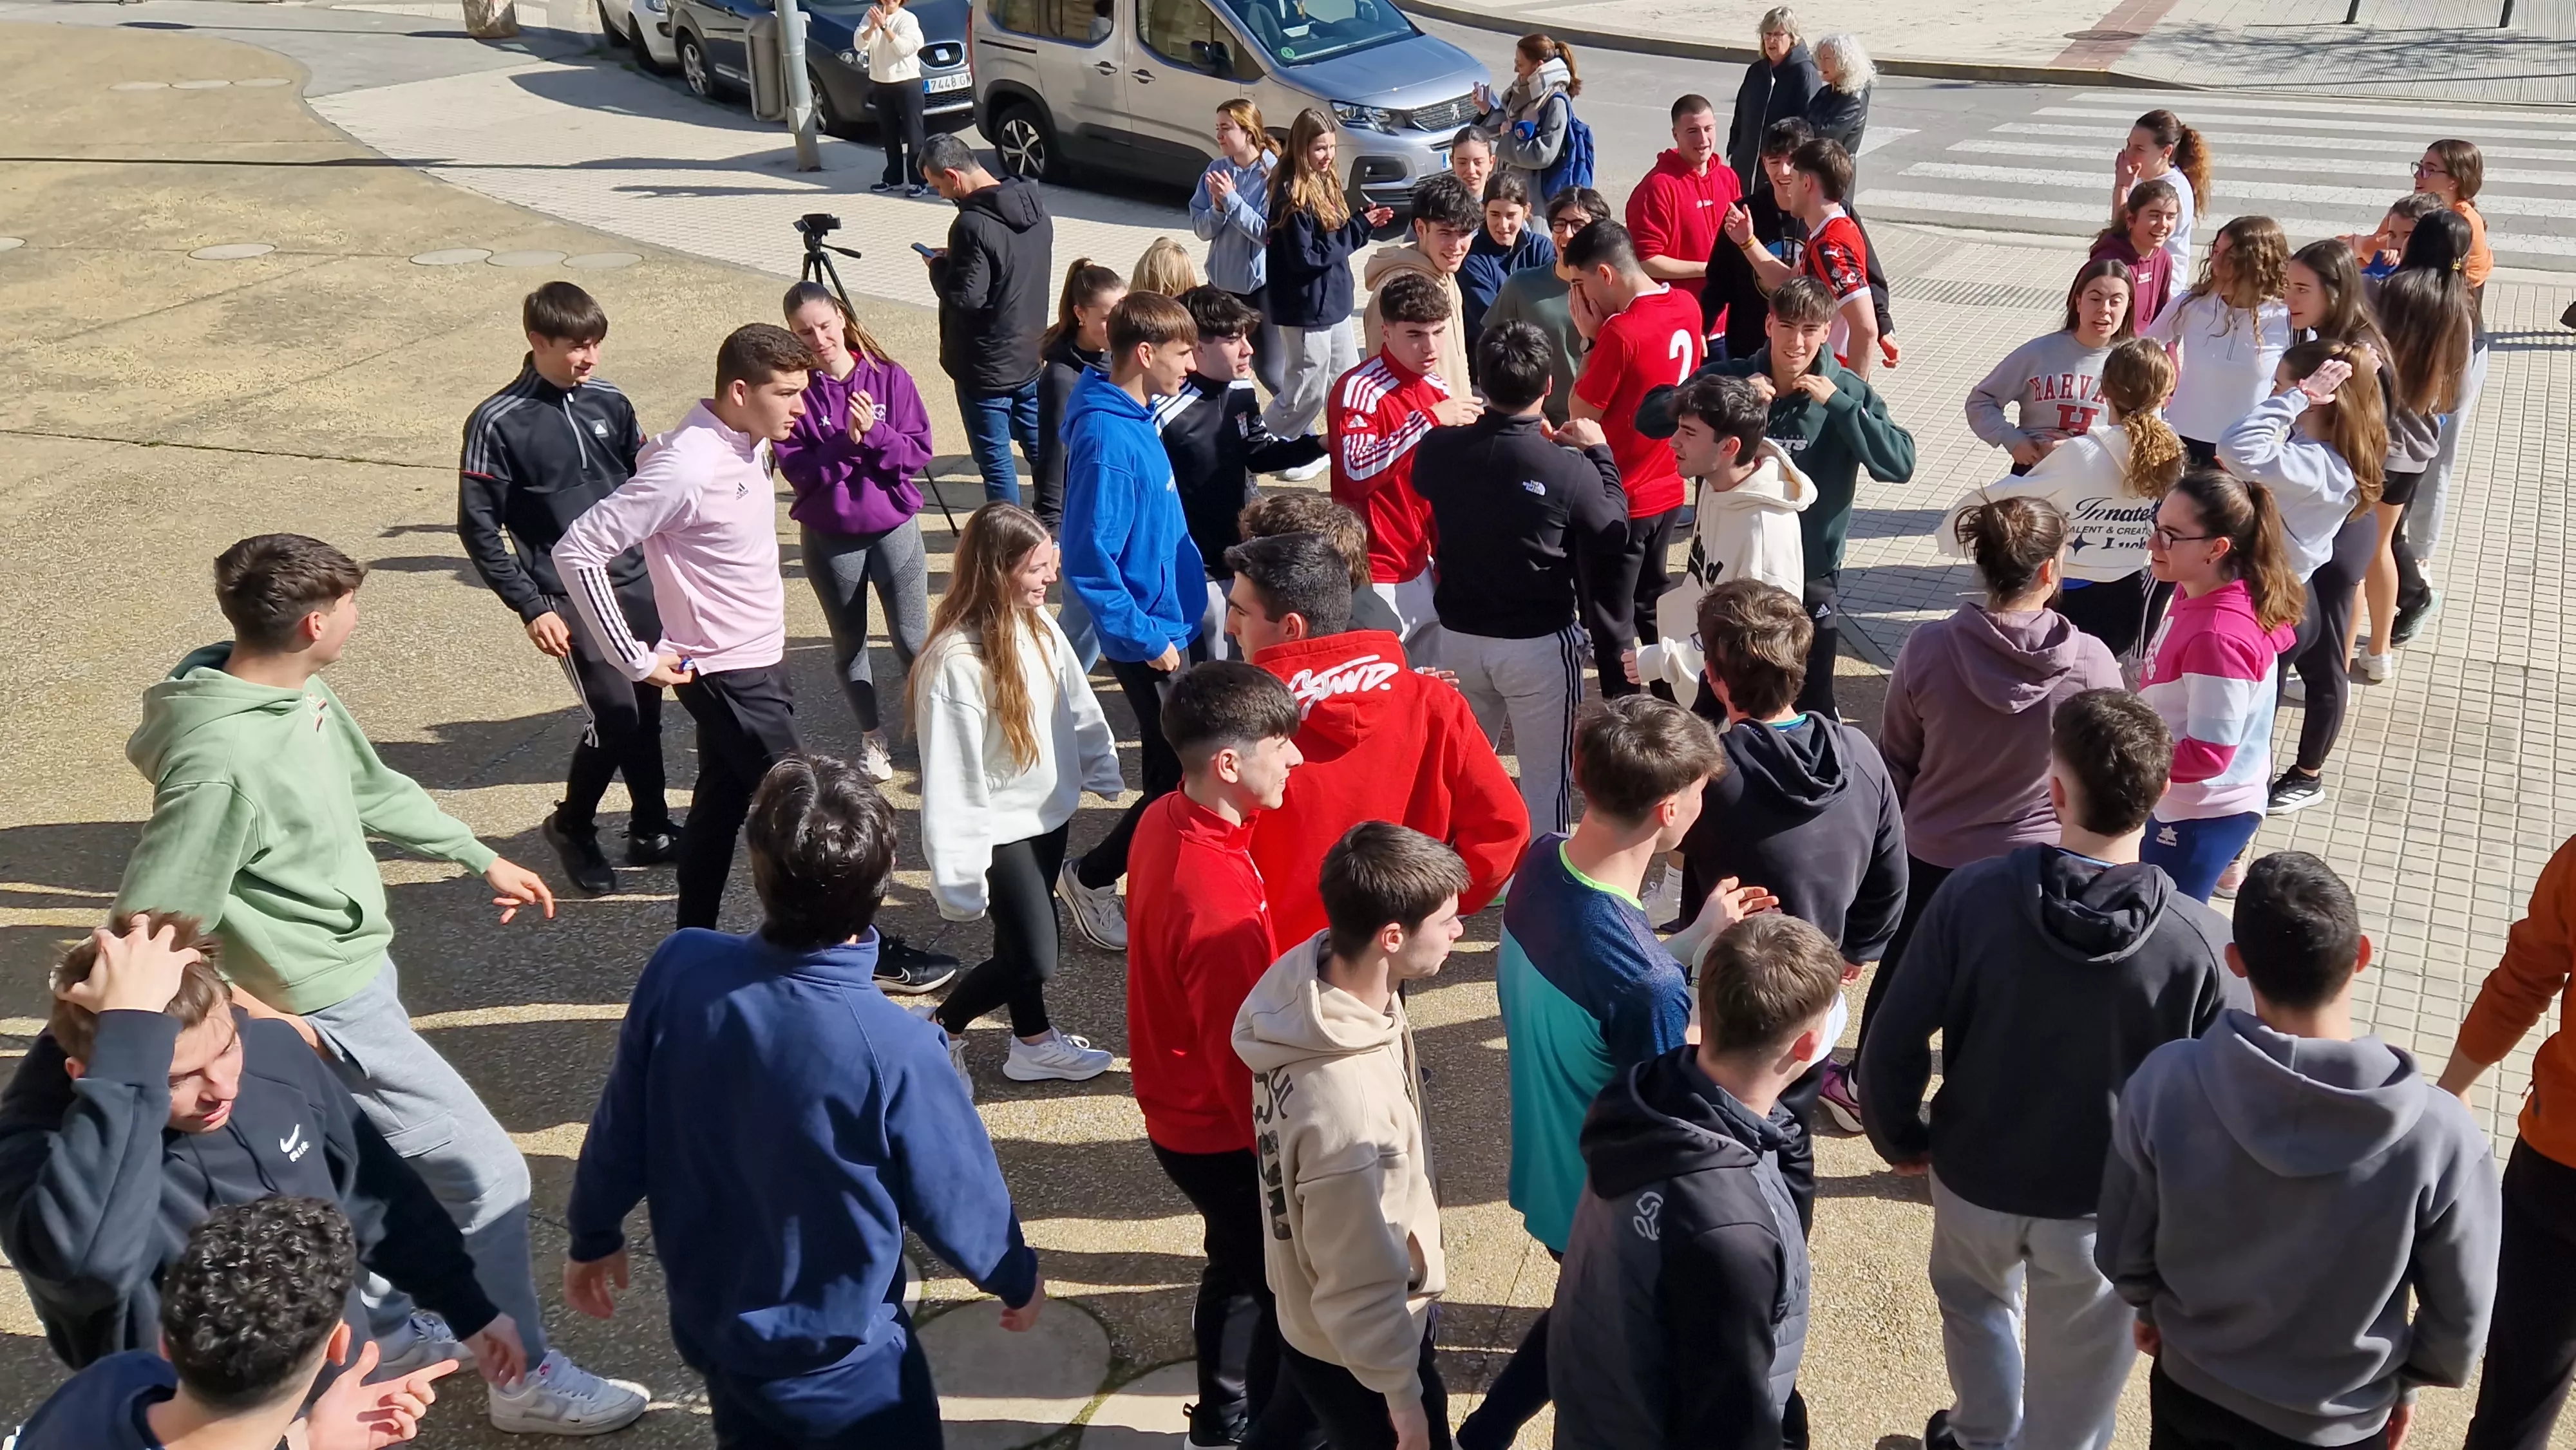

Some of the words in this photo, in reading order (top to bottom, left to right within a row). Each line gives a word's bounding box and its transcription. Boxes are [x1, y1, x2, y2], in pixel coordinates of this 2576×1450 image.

[931, 76, 957, 91] 7448
[1831, 272, 1857, 294] MSC
[1669, 328, 1693, 387] 2
[2029, 374, 2107, 404] HARVA
[2069, 497, 2150, 522] Innate
[2069, 525, 2104, 534] ALENT
[2106, 525, 2114, 534] &
